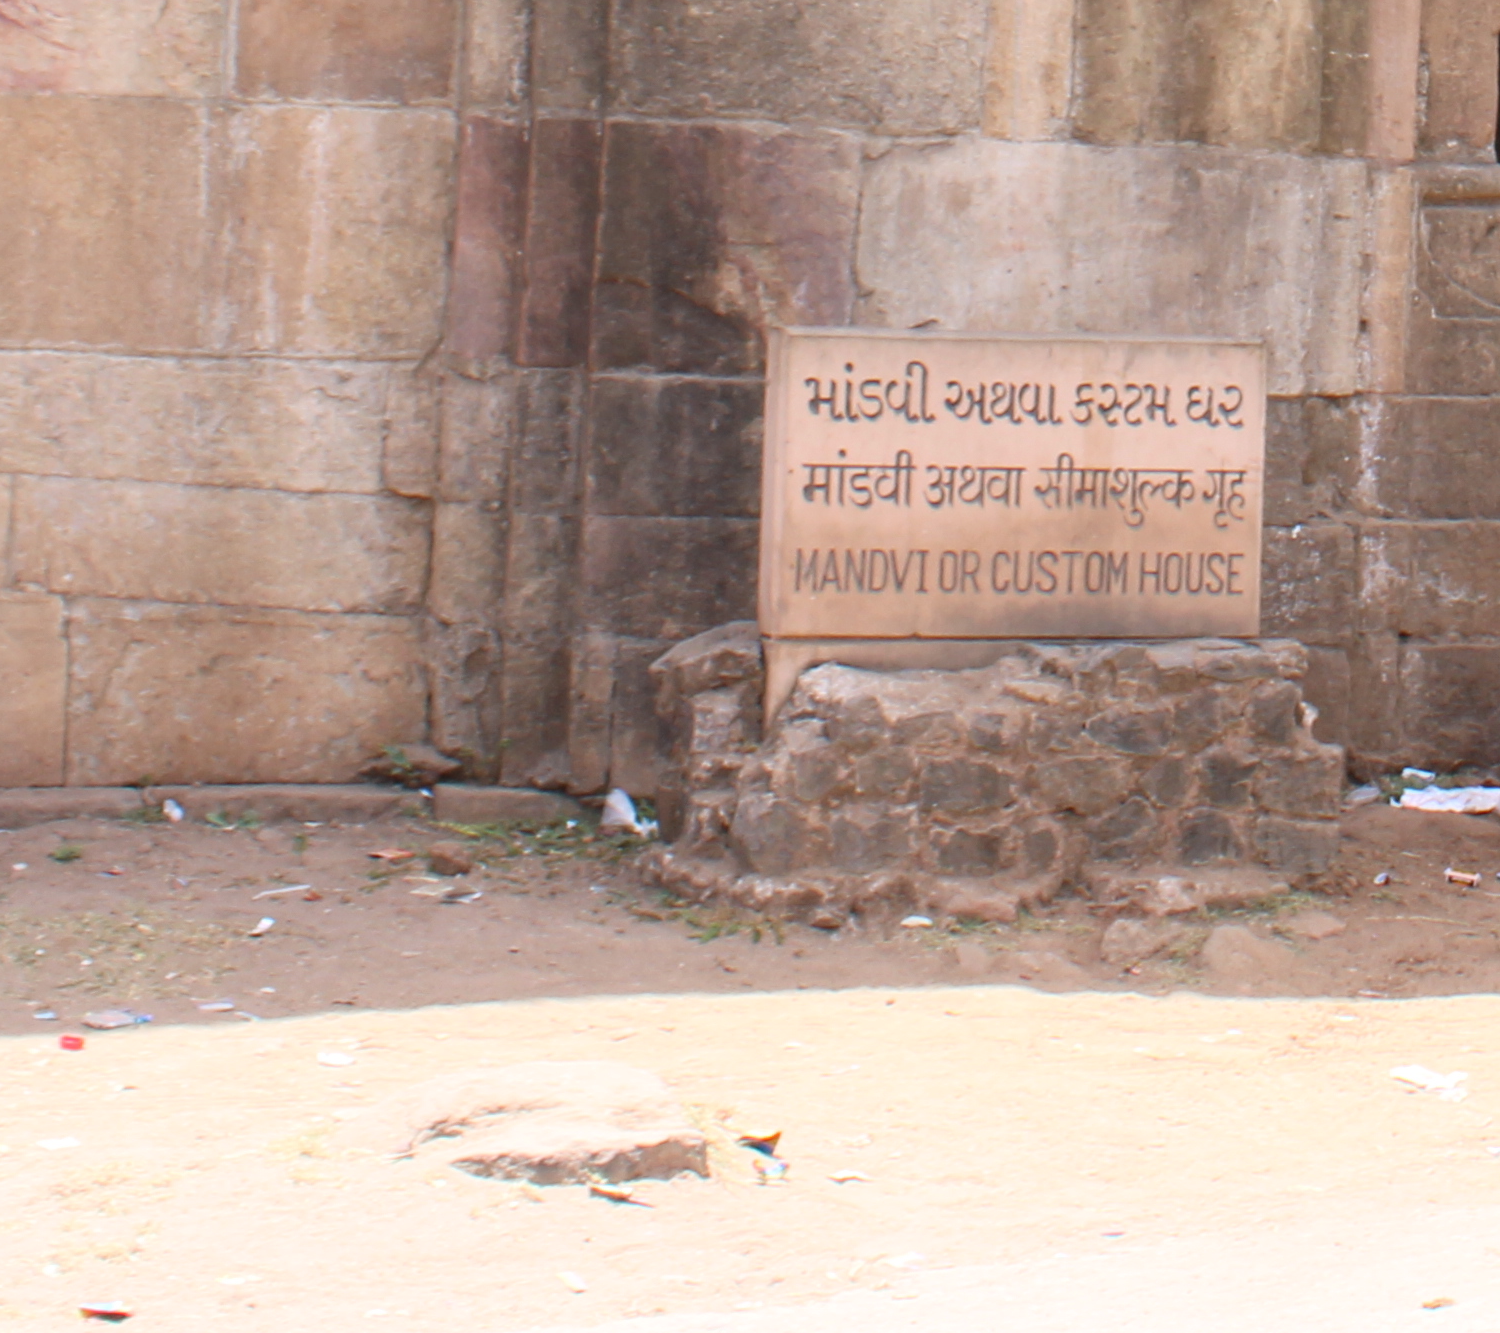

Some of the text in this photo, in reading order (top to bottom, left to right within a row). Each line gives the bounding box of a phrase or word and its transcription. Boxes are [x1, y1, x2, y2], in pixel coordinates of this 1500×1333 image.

[804, 361, 1245, 428] માંડવી અથવા કસ્ટમ ઘર
[801, 449, 1247, 529] मांडवी अथवा सीमाशुल्क गृह
[794, 548, 1245, 596] MANDVI OR CUSTOM HOUSE
